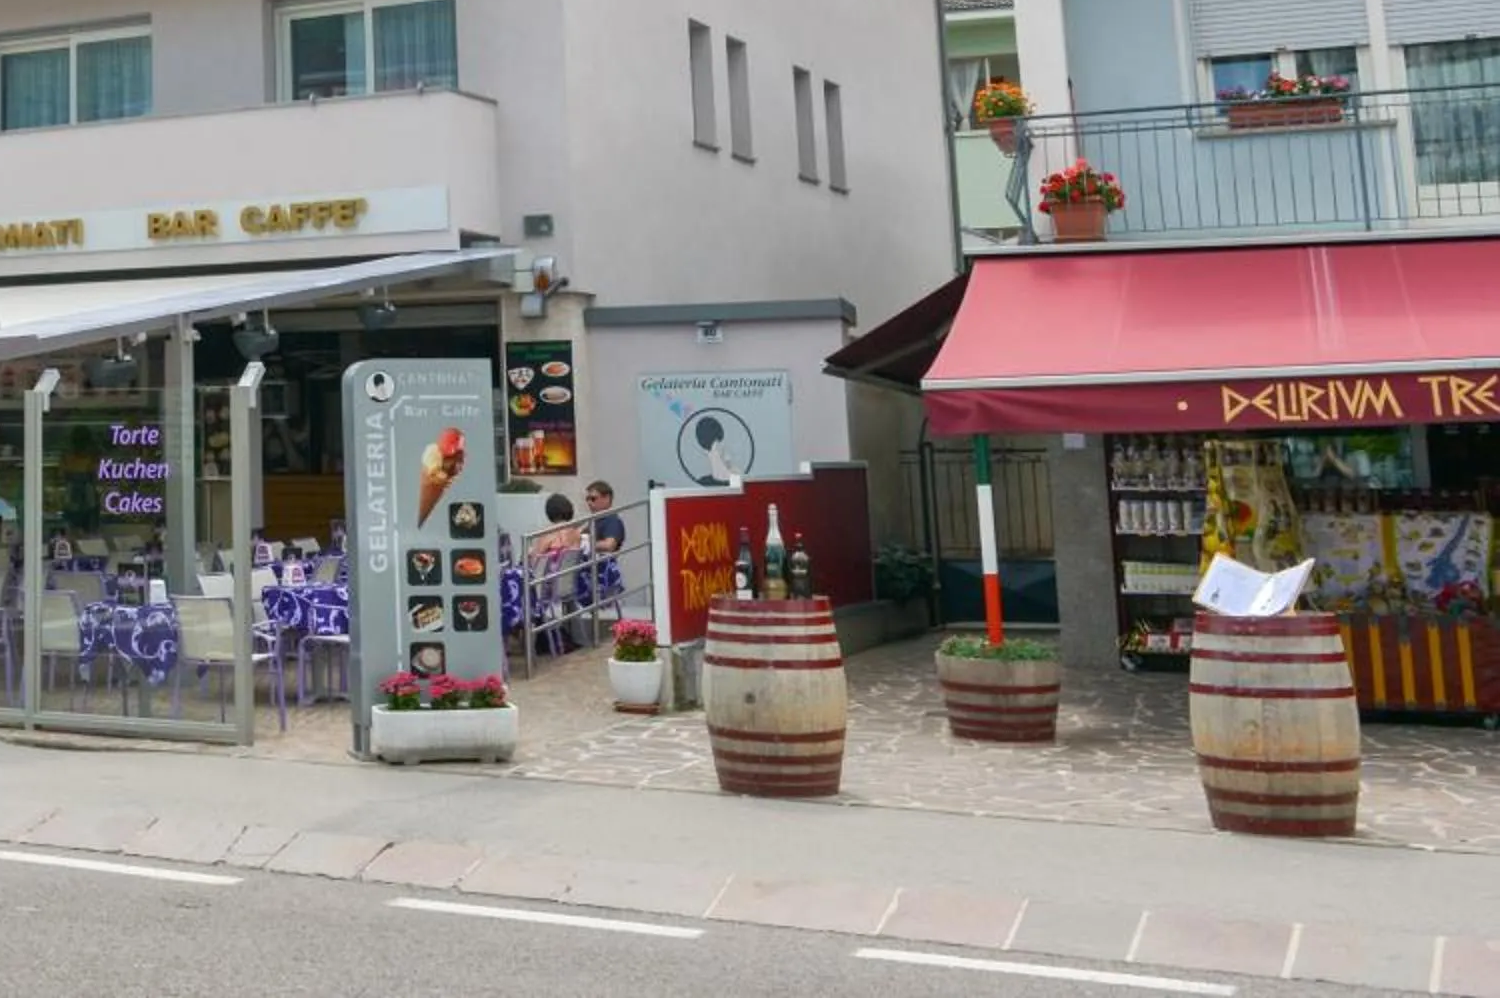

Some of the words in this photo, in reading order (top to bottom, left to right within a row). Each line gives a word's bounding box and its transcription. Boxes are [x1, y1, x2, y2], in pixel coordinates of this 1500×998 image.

[147, 208, 218, 239] BAR
[641, 376, 706, 391] Gelateria
[710, 374, 783, 390] Cantonati
[1417, 375, 1500, 416] TRE
[111, 425, 160, 445] Torte
[98, 458, 170, 479] Kuchen
[105, 491, 163, 514] Cakes
[366, 411, 389, 573] GELATERIA
